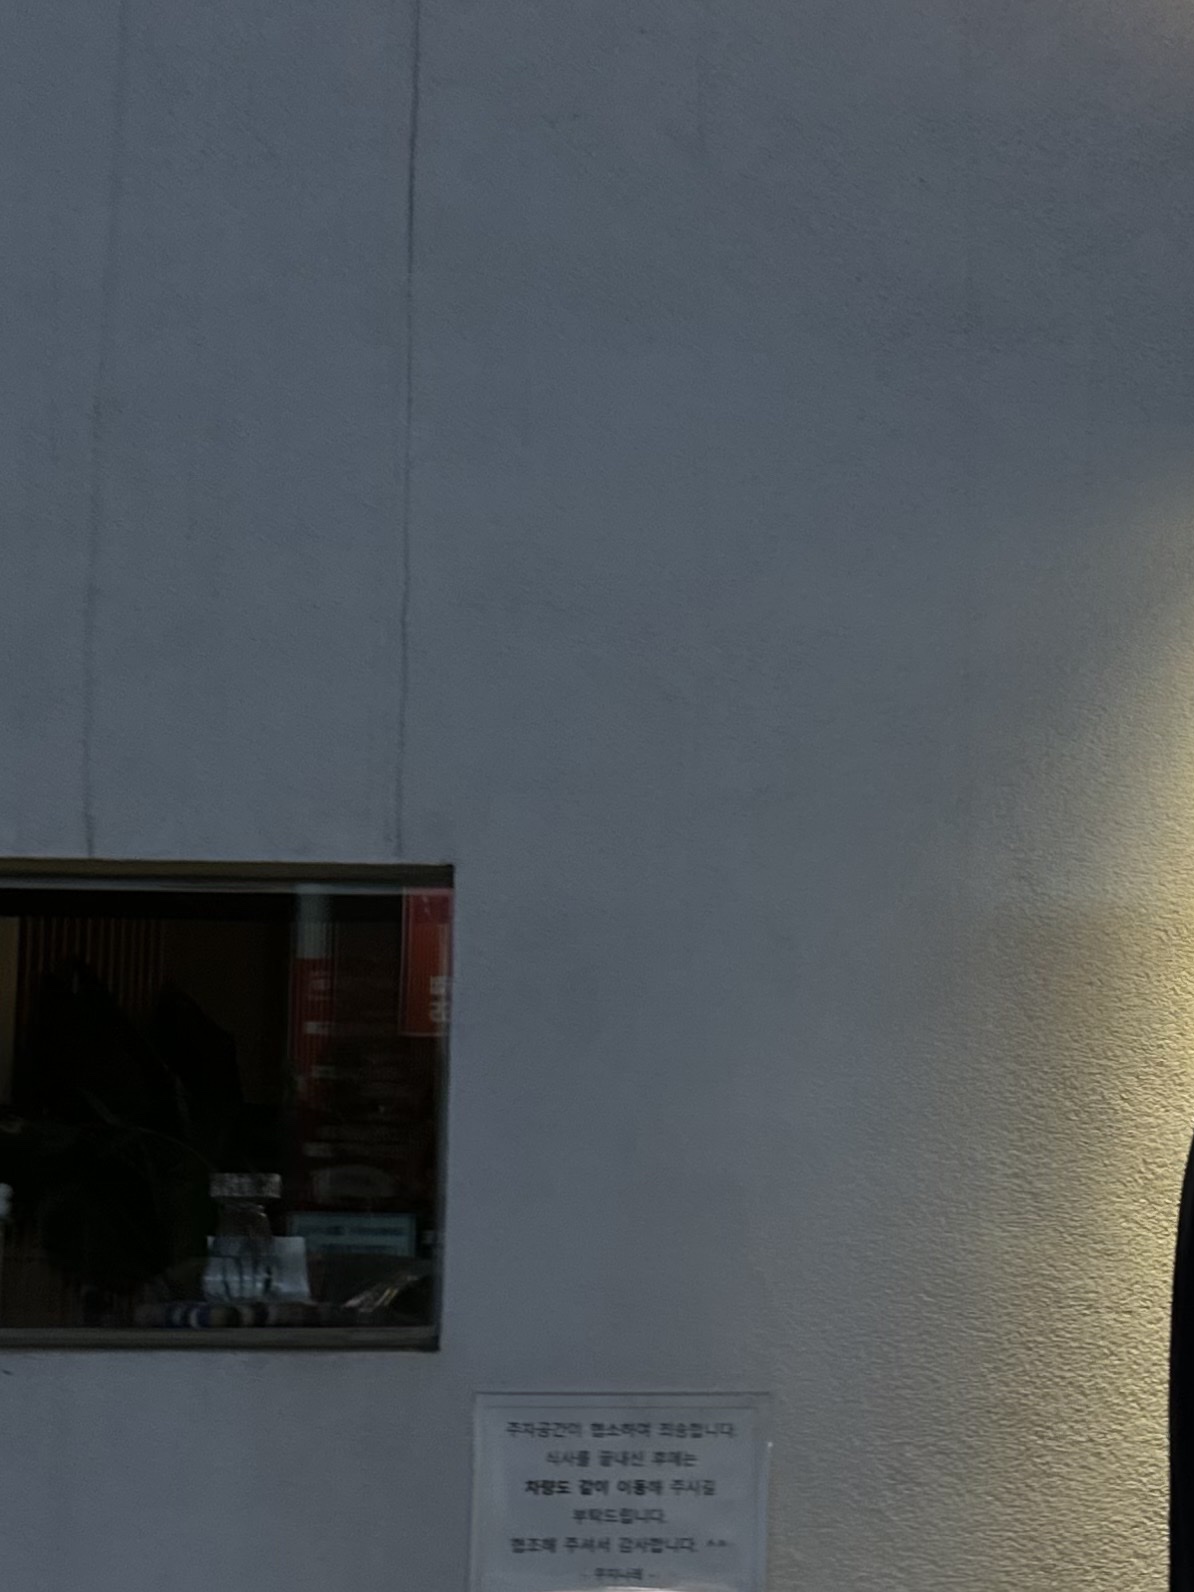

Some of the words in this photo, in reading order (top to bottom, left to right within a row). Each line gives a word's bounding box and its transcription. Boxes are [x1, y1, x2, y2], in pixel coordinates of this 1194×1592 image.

[525, 1479, 572, 1496] 차량도
[578, 1479, 610, 1496] 같이
[616, 1479, 663, 1496] 이동해
